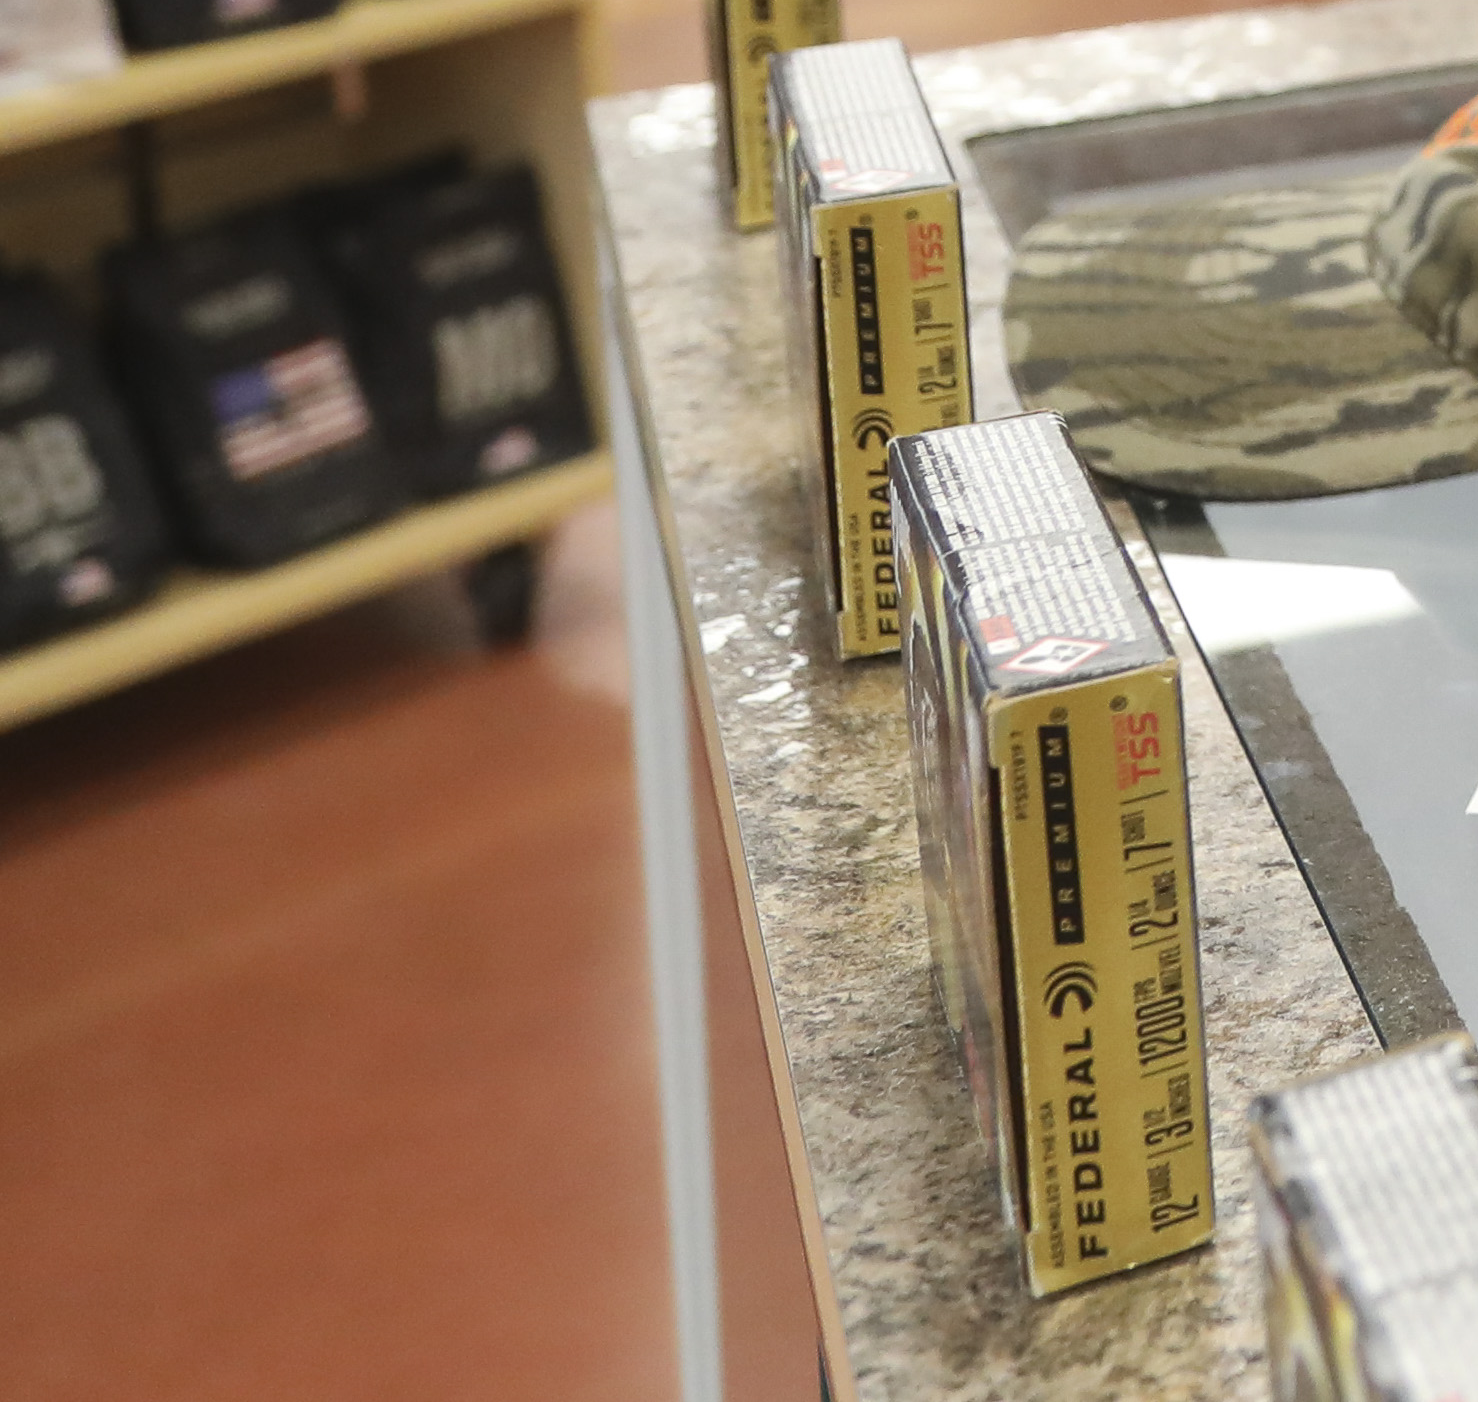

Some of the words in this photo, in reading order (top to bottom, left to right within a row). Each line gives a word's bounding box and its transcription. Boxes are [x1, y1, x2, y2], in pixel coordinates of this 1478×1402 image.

[918, 222, 945, 278] TSS
[853, 236, 881, 389] PREMIUM
[914, 322, 955, 336] 7
[918, 376, 958, 395] 2
[1127, 711, 1161, 786] TSS
[1045, 736, 1077, 934] PREMIUM
[1124, 841, 1174, 861] 7
[1129, 911, 1178, 937] 2
[1135, 995, 1188, 1066] 1200
[1063, 1027, 1108, 1261] FEDERAL
[1144, 1119, 1194, 1146] 3
[1151, 1194, 1200, 1234] 12
